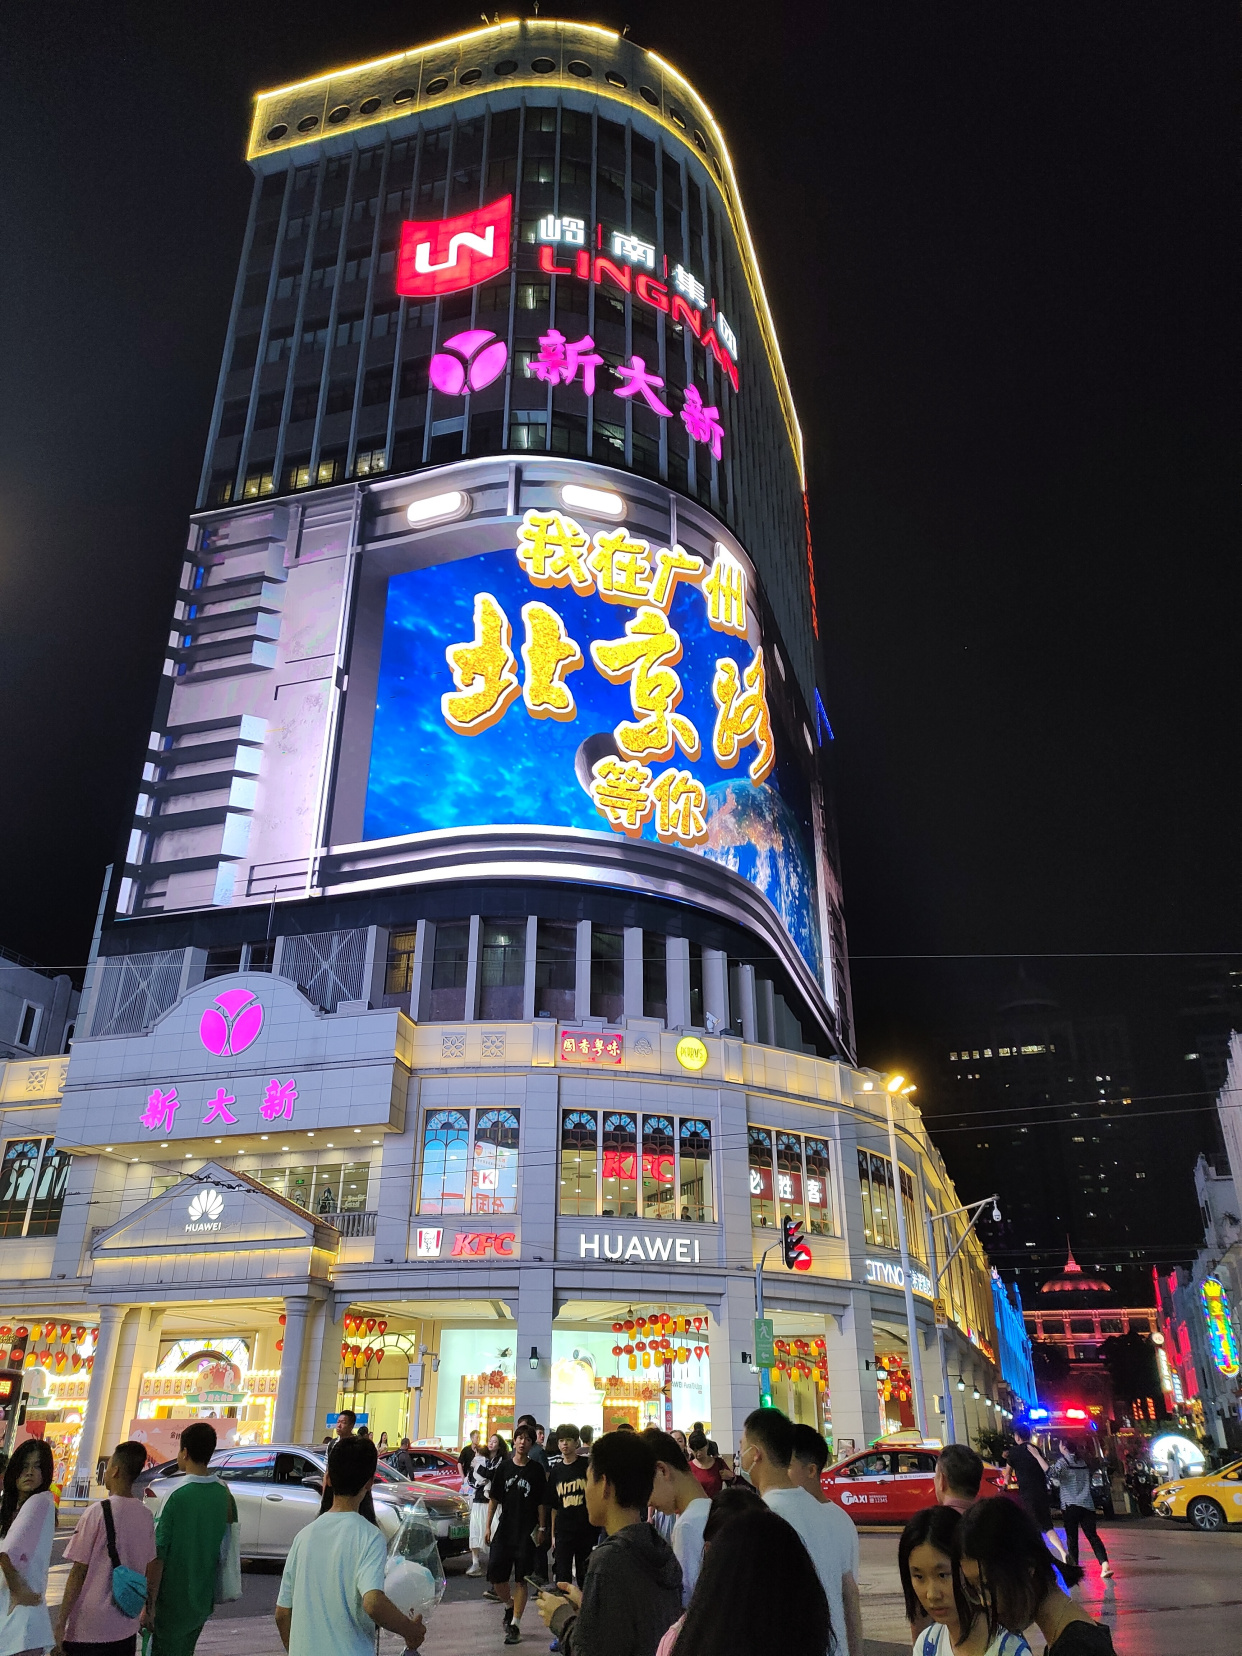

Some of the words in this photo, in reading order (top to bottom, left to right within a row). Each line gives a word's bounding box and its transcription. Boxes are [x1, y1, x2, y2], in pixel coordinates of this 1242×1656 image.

[539, 246, 739, 393] LINGNAN
[527, 329, 725, 461] 新大新
[517, 510, 748, 631] 我在广州
[590, 755, 706, 837] 等你
[140, 1079, 298, 1133] 新大新
[602, 1150, 675, 1183] KFC
[750, 1169, 822, 1203] 必胜客
[185, 1222, 222, 1233] HUAWEI
[450, 1232, 516, 1256] KFC
[580, 1234, 700, 1263] HUAWEI
[843, 1493, 868, 1504] TAXI
